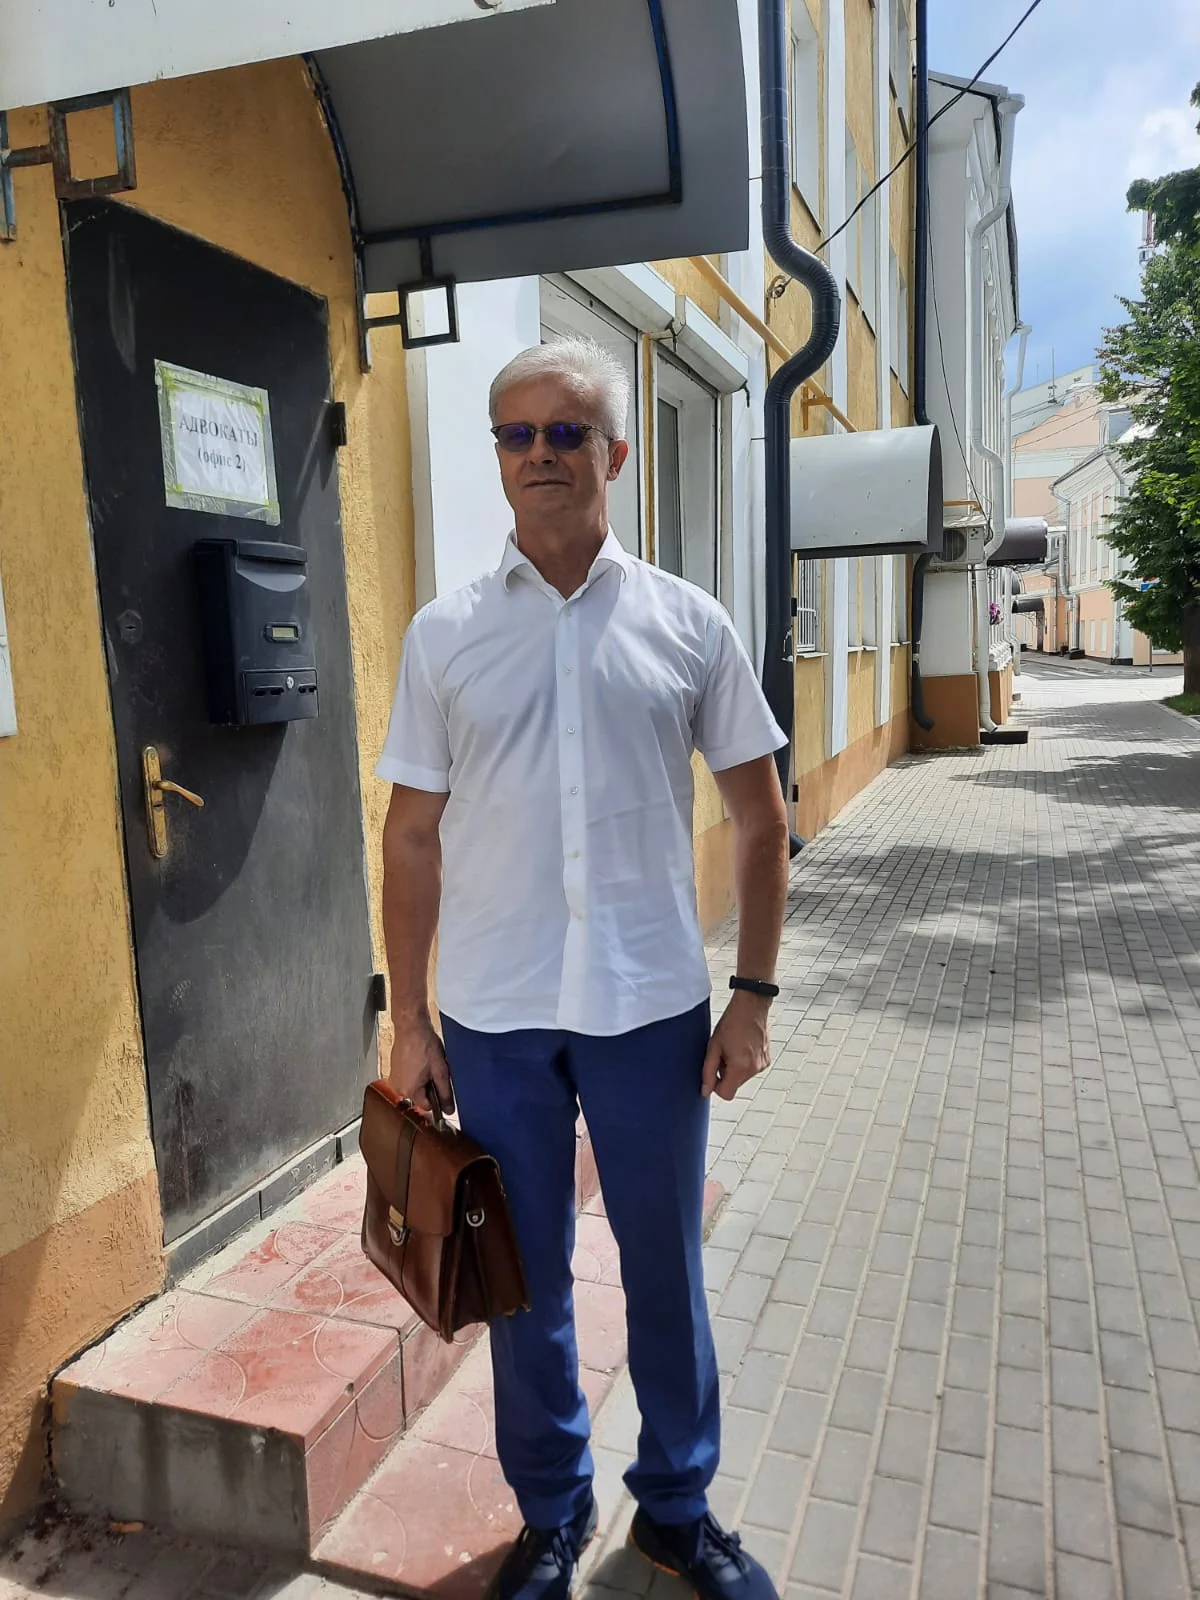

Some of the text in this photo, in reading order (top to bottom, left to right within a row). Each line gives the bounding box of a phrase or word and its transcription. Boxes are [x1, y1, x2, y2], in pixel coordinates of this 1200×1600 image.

[179, 414, 258, 447] АДВОКАТЫ
[198, 447, 246, 473] (офис 2)
